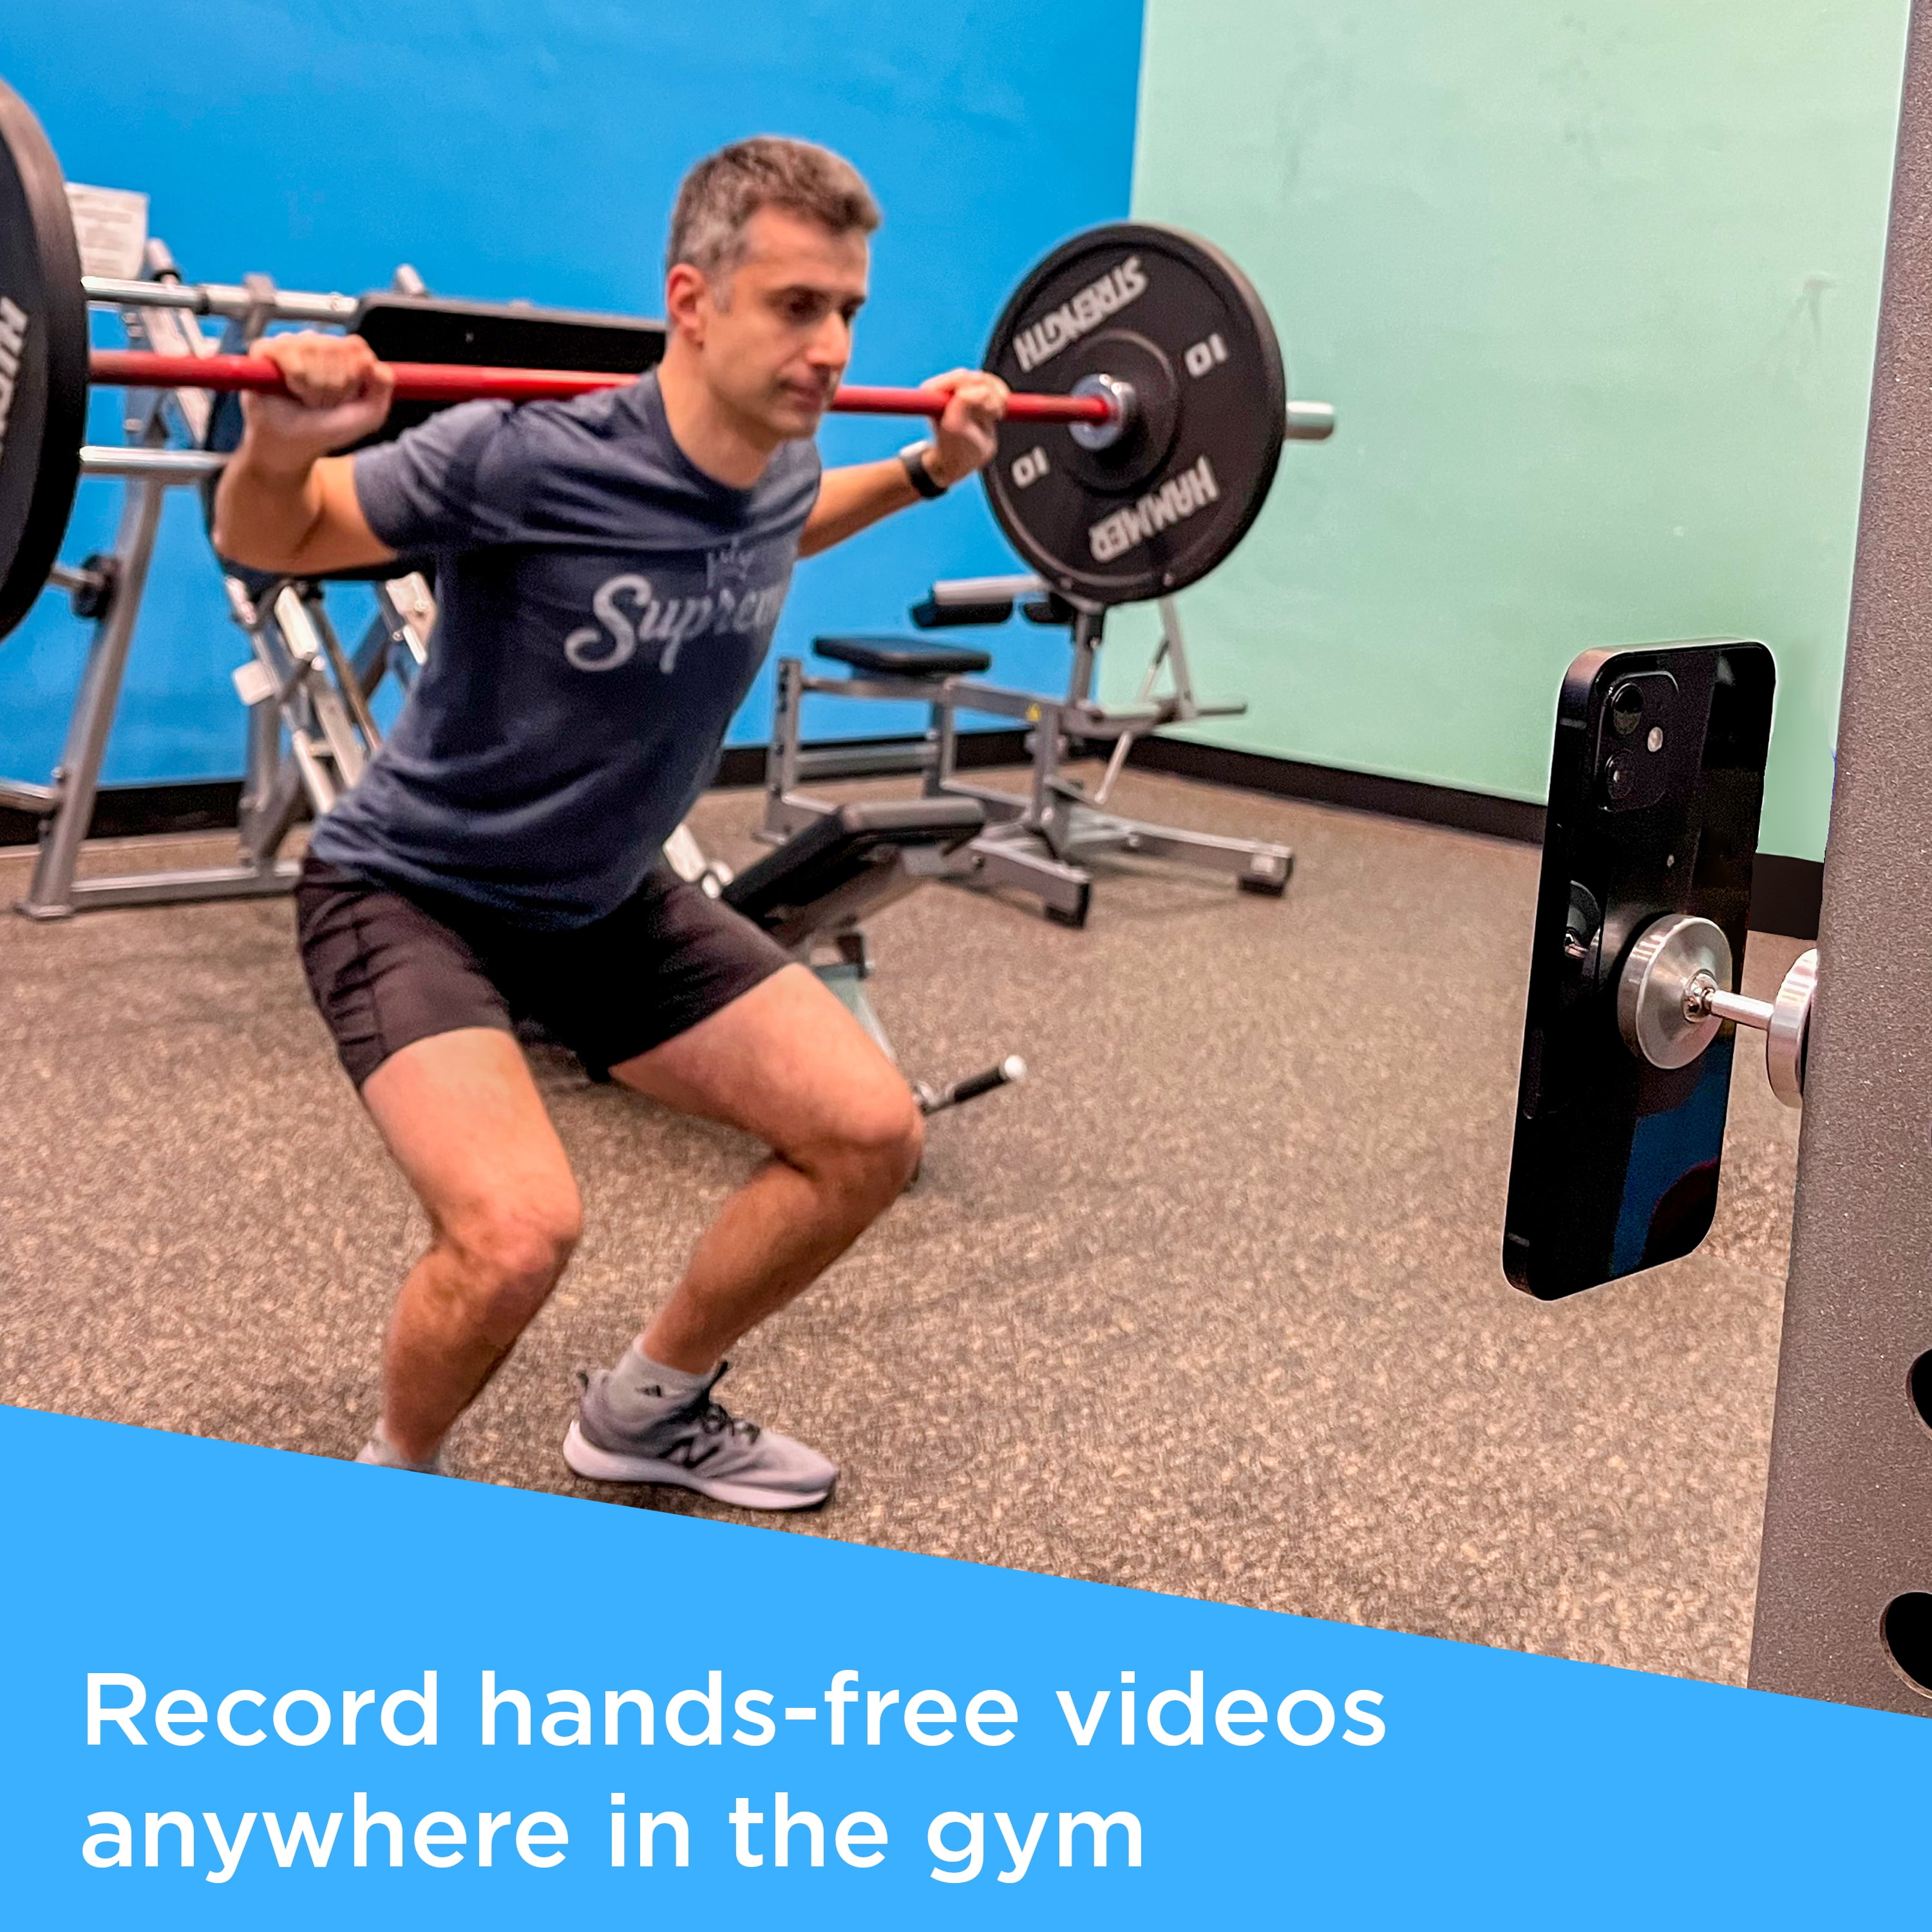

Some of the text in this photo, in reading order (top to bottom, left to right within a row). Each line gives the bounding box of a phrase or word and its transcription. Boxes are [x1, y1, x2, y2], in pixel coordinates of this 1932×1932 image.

[1013, 257, 1148, 372] STRENGTH
[1184, 333, 1227, 377] 10
[1011, 447, 1050, 488] 10
[1089, 455, 1219, 563] HAMMER
